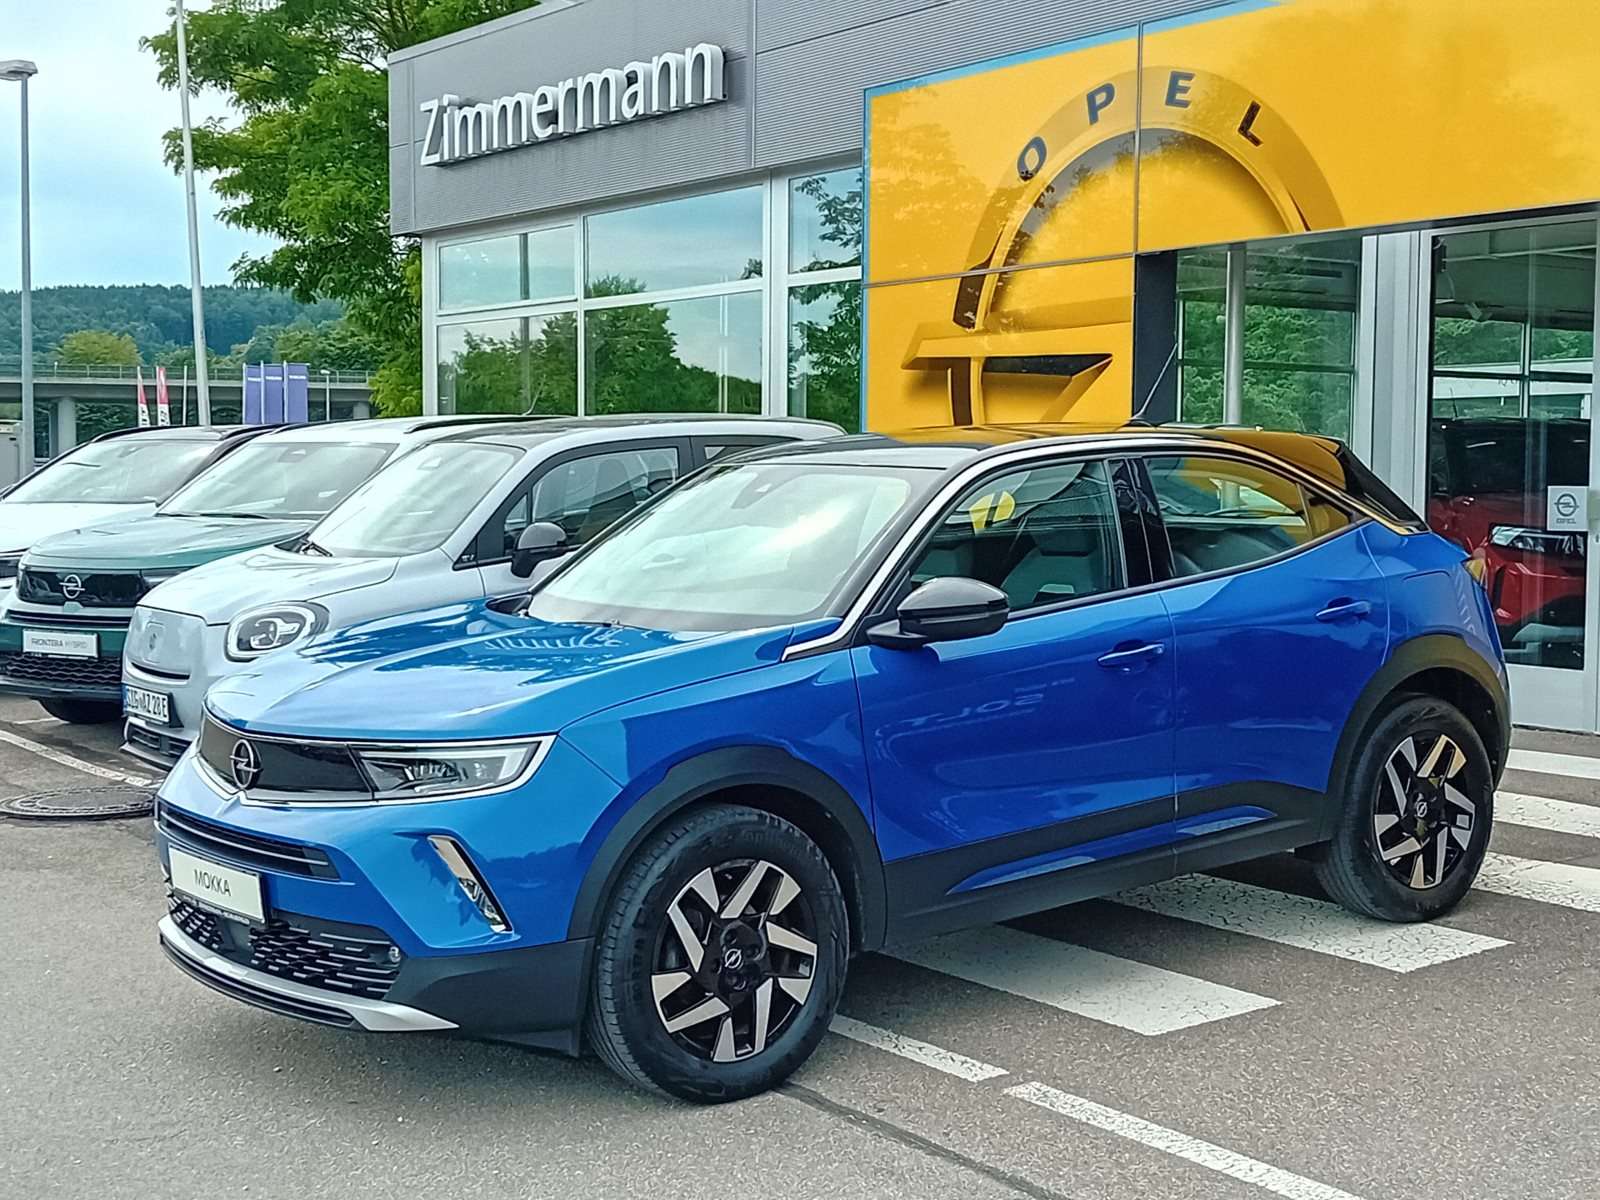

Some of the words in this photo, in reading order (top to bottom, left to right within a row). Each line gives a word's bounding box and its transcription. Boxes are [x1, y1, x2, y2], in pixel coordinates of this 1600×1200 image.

[420, 43, 727, 166] Zimmermann
[1017, 71, 1263, 181] OPEL
[194, 869, 232, 897] MOKKA
